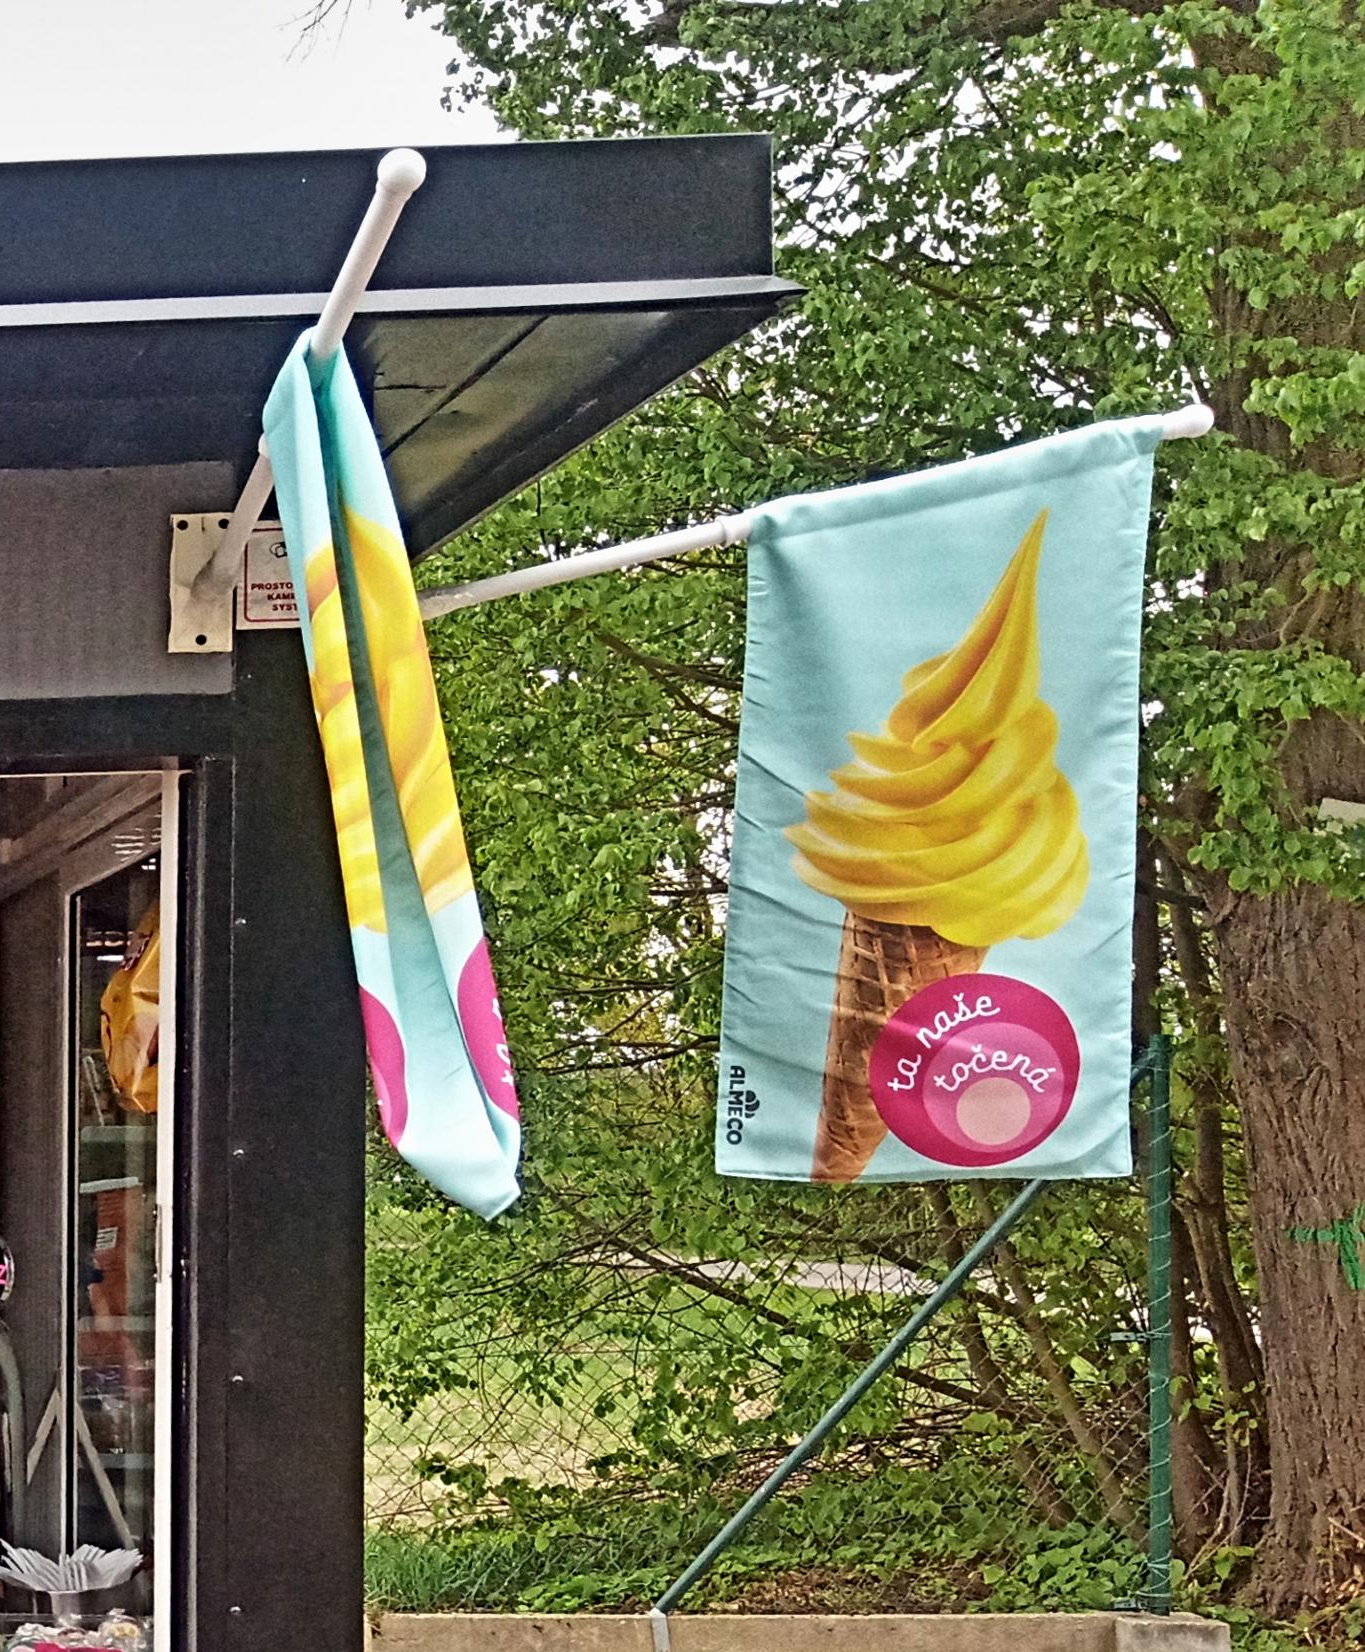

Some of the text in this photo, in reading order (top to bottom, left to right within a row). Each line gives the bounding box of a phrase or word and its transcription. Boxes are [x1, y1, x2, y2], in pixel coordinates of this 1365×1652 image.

[916, 992, 1000, 1048] naše
[933, 1044, 1055, 1092] točená
[727, 1064, 746, 1146] ALMECO
